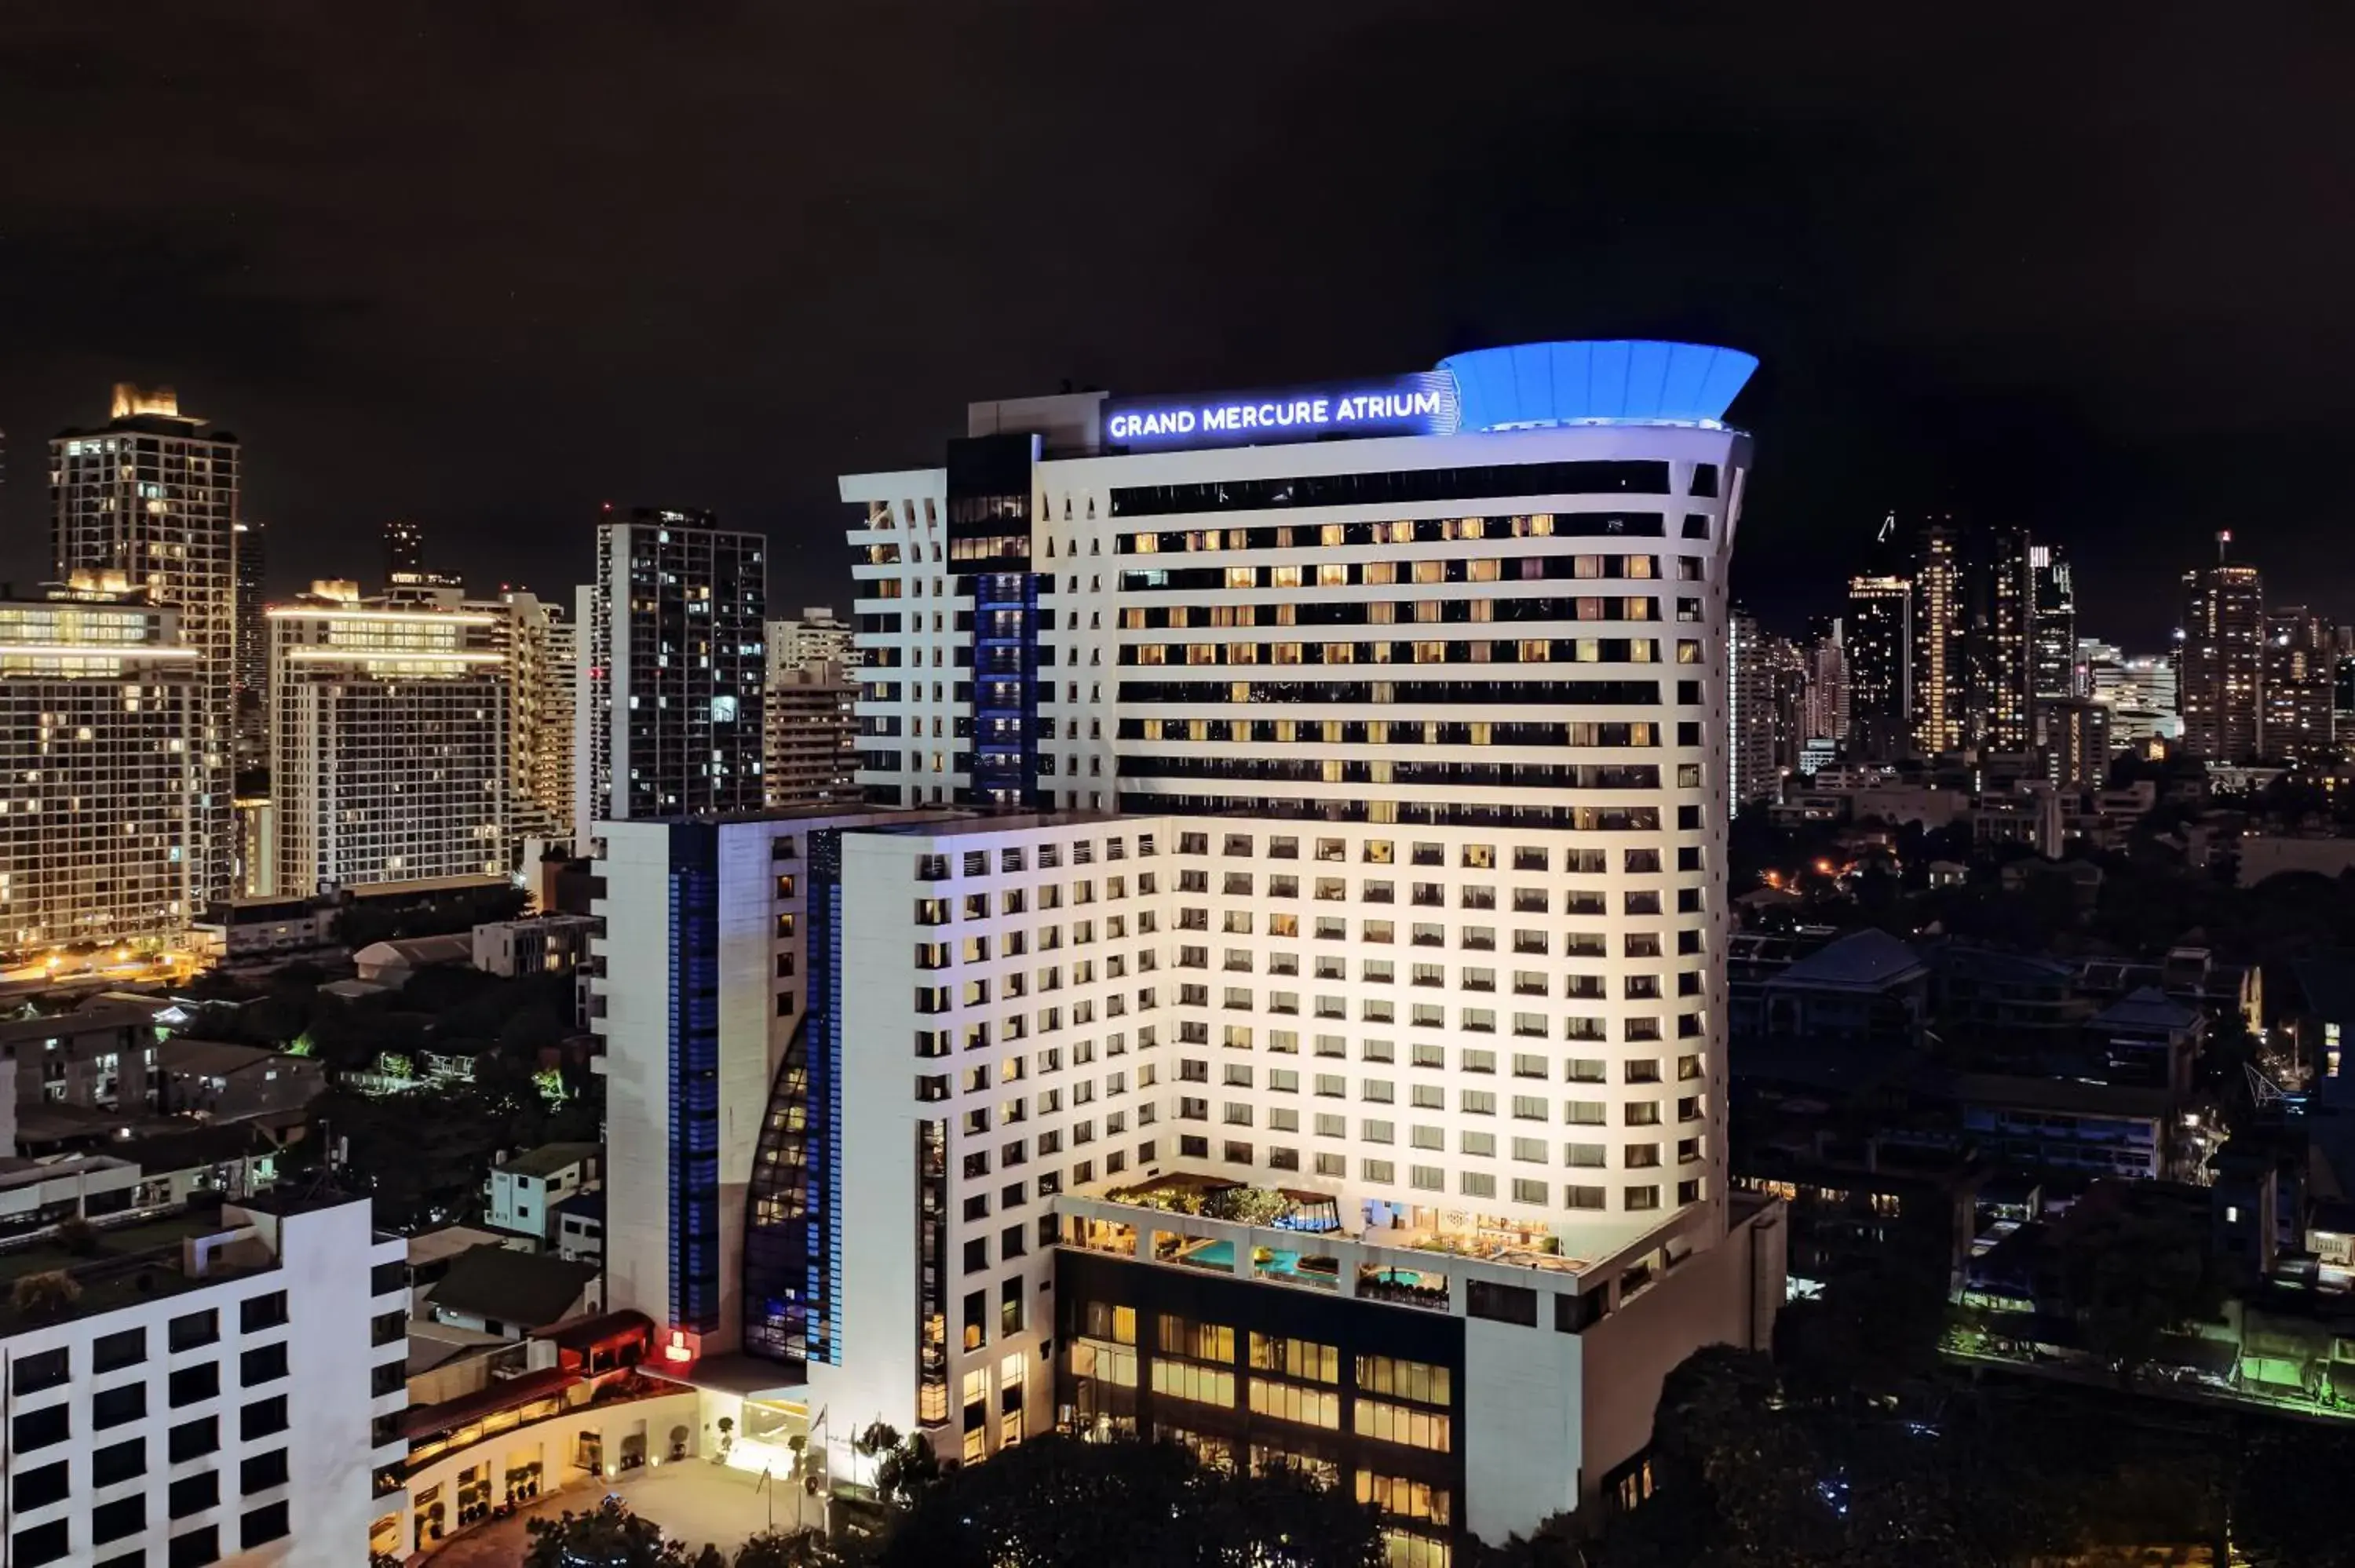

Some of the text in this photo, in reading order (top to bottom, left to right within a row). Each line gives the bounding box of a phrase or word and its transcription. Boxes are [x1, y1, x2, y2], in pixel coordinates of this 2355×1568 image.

[1110, 391, 1441, 438] GRAND MERCURE ATRIUM
